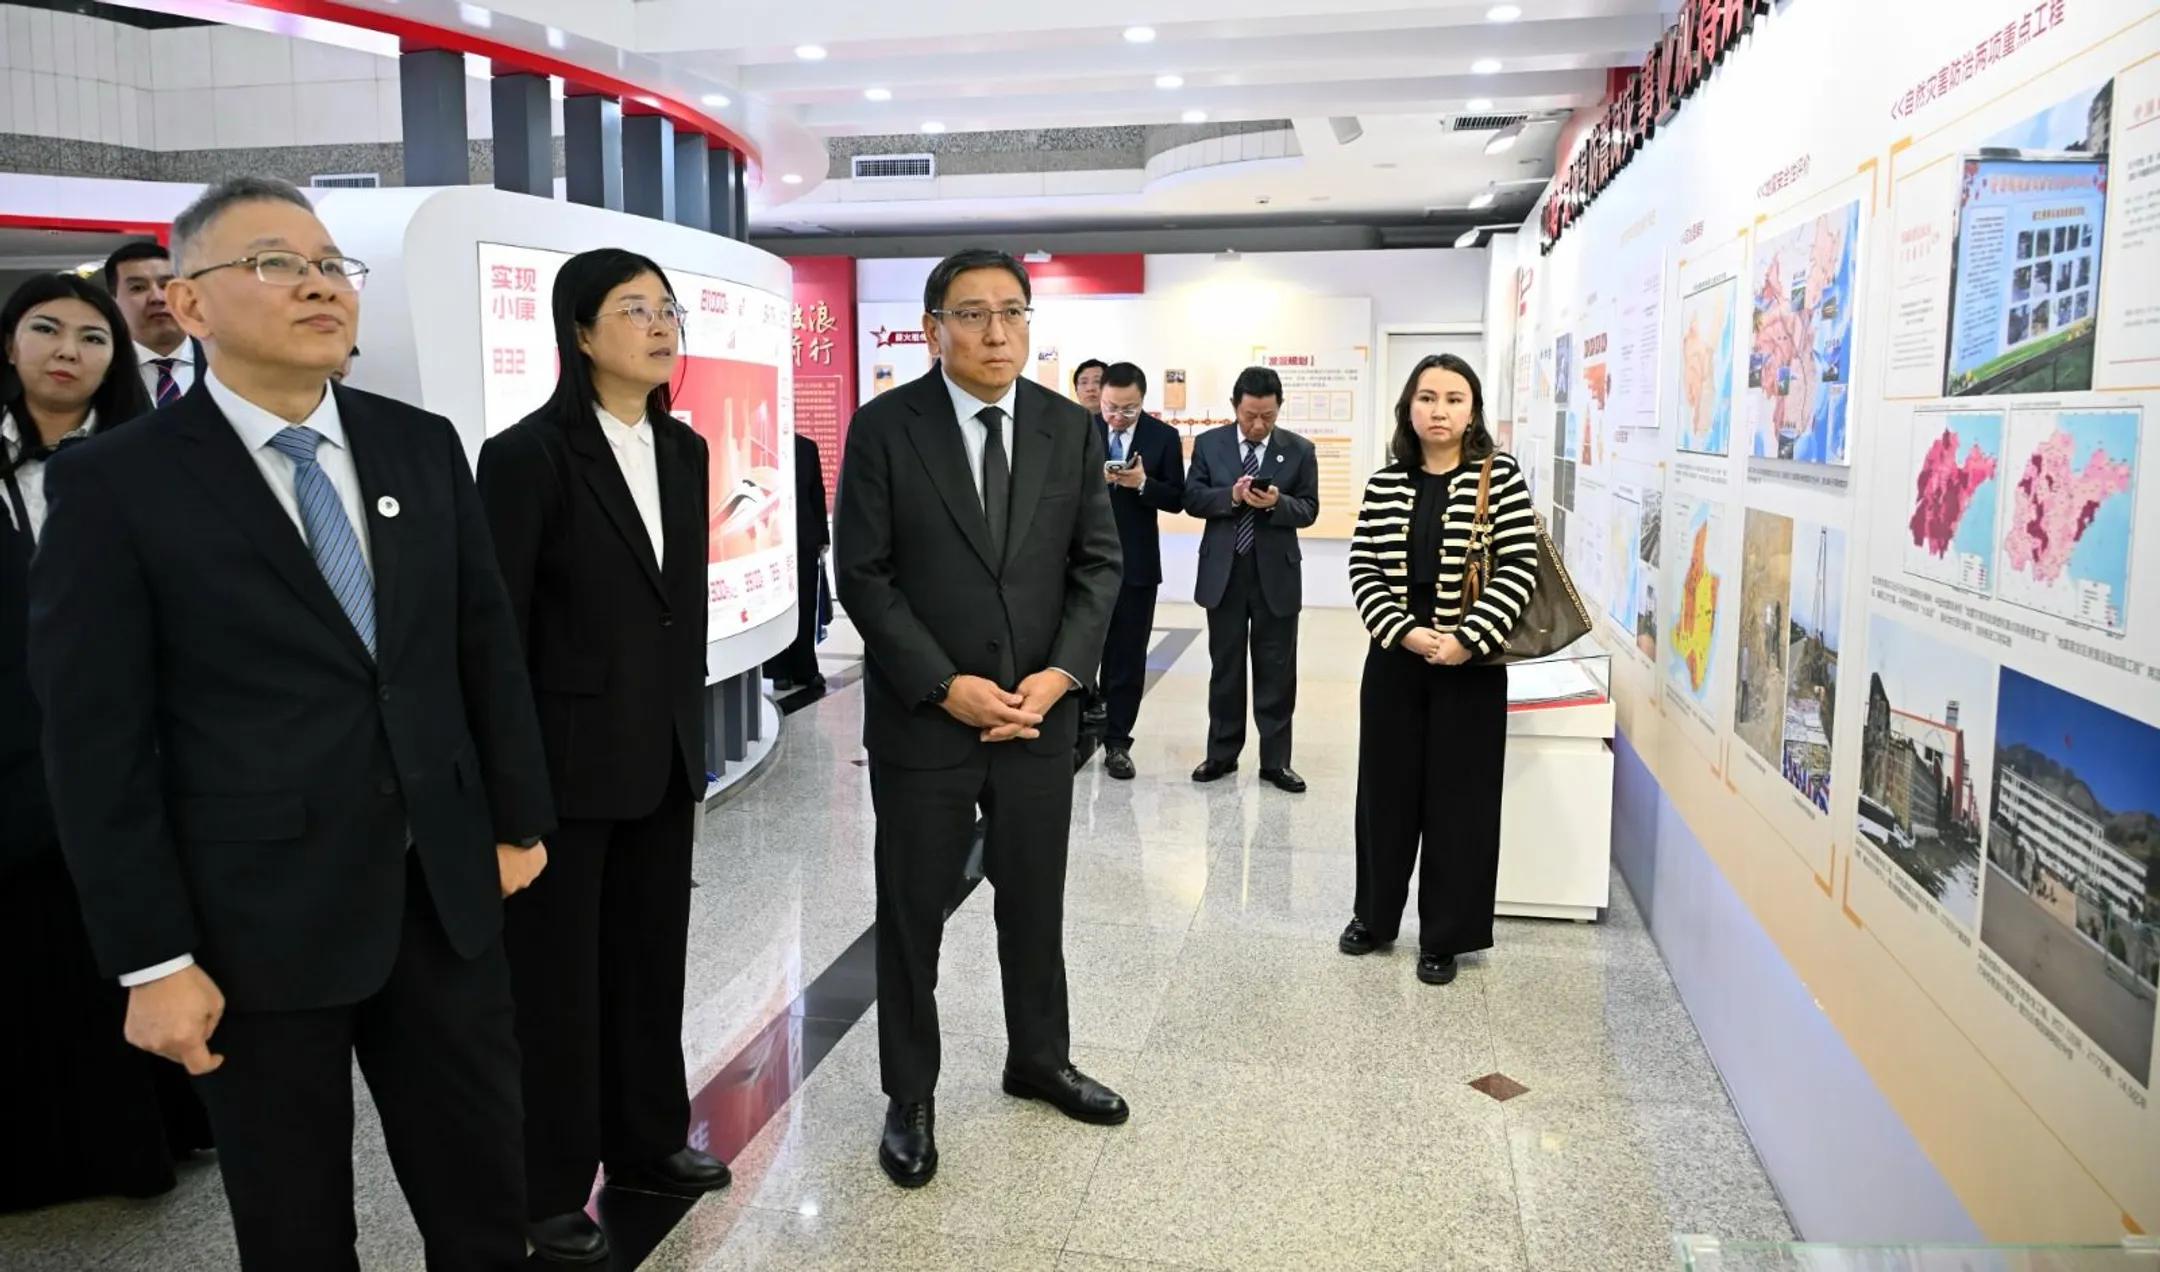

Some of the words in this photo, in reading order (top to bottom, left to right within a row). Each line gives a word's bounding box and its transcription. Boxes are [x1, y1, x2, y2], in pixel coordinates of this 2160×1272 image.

[491, 264, 536, 292] 实现
[492, 294, 536, 320] 小康
[493, 348, 525, 375] 832
